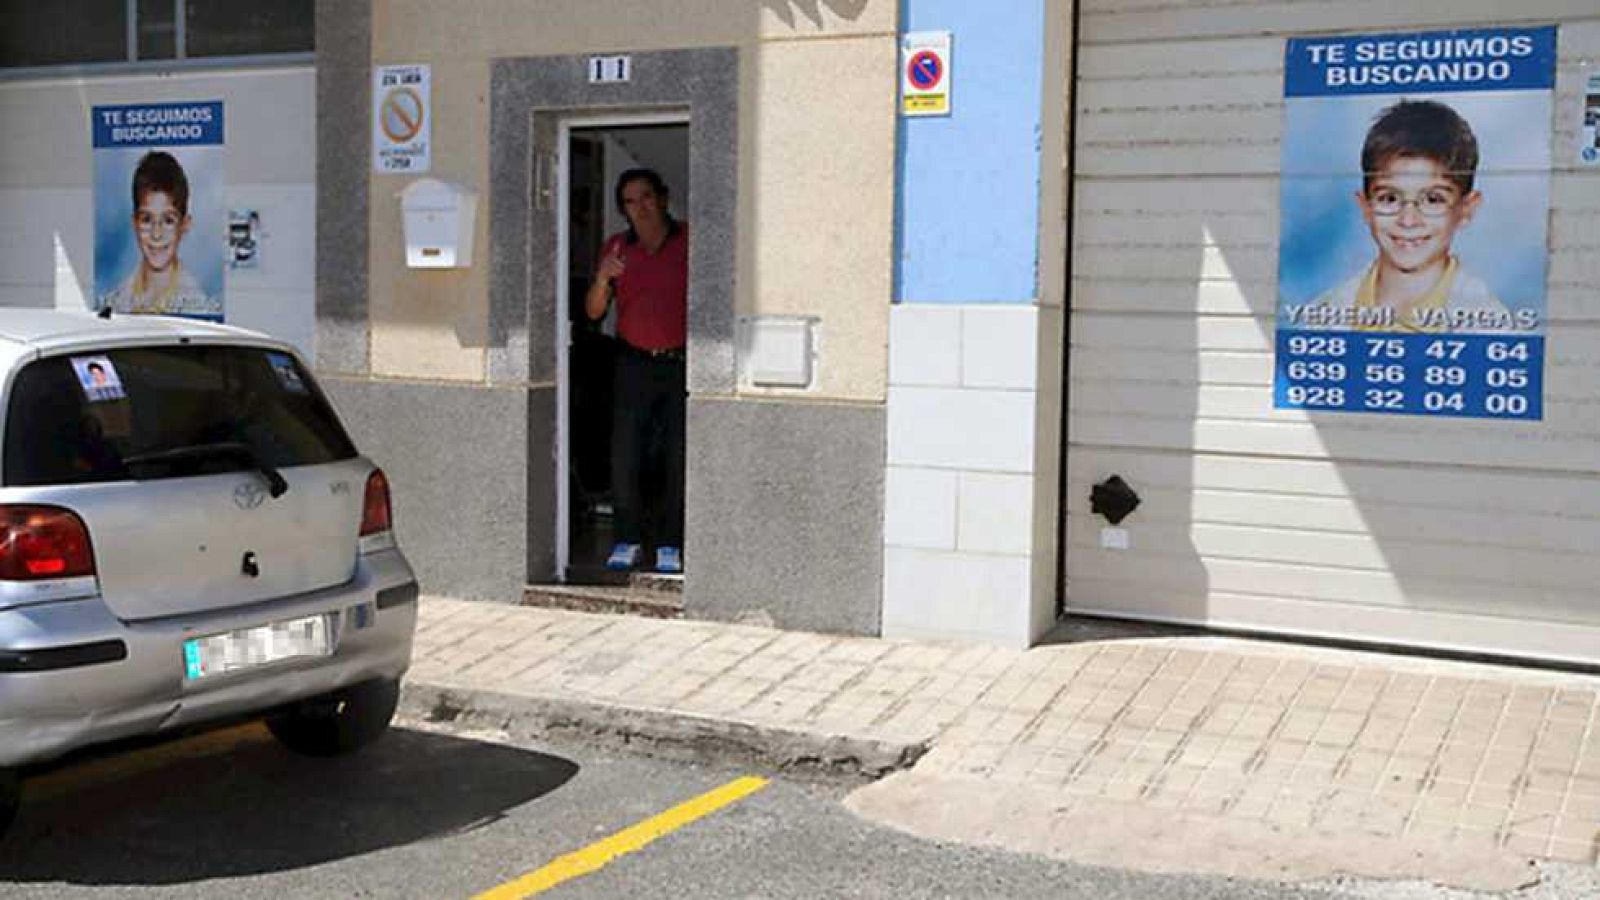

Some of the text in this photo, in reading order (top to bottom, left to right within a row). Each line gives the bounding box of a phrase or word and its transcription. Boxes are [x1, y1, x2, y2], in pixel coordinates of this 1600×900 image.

[1306, 36, 1533, 64] TE SEGUIMOS
[1326, 60, 1511, 86] BUSCANDO
[102, 106, 212, 126] TE SEGUIMOS
[112, 124, 203, 142] BUSCANDO
[1284, 303, 1539, 330] YEREMI VARGAS
[1287, 336, 1529, 362] 928 75 47 64
[1287, 360, 1529, 389] 639 56 89 05
[1286, 386, 1529, 414] 928 32 04 00
